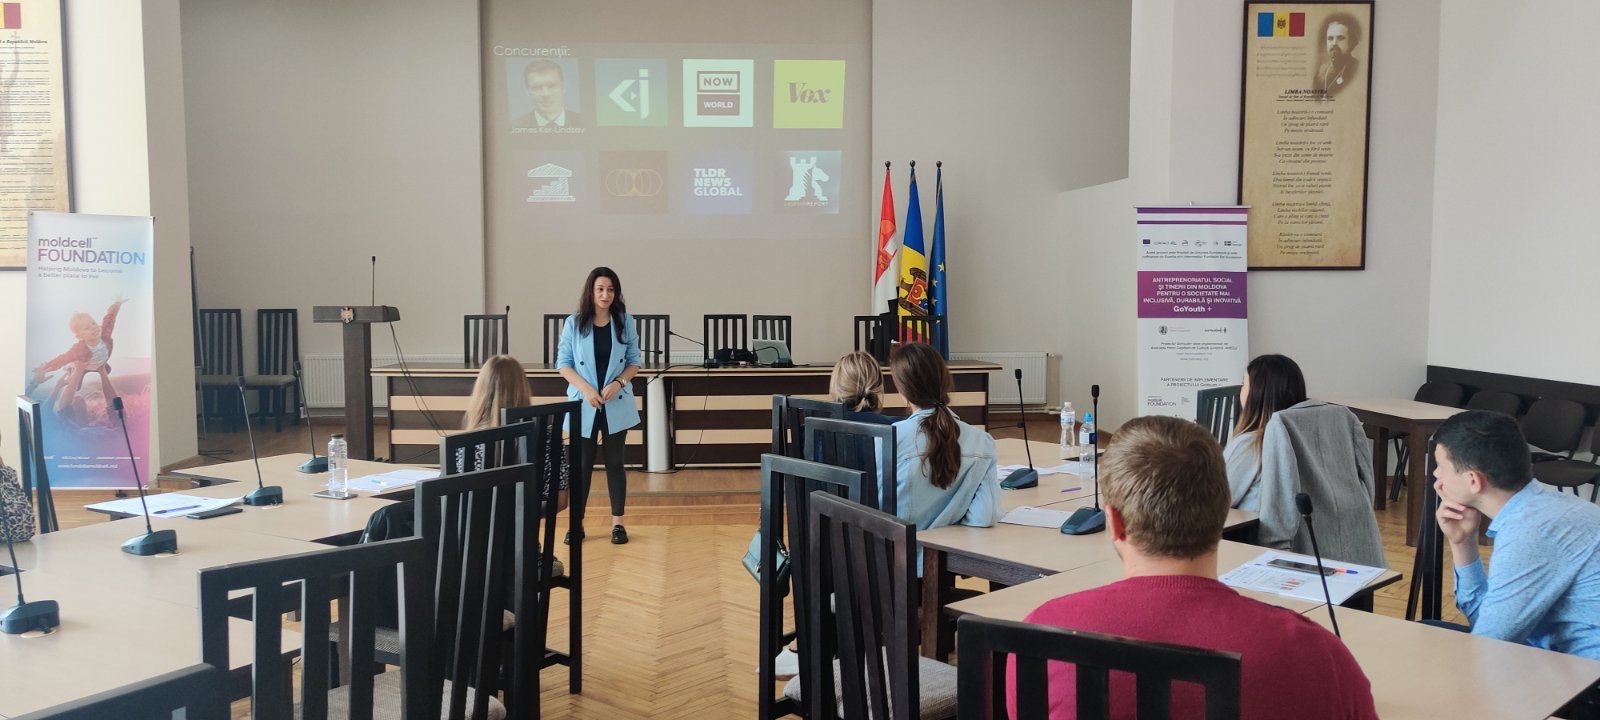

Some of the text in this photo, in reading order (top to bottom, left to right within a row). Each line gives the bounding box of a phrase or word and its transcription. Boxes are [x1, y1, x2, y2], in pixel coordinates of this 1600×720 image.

[704, 77, 734, 87] NOW
[788, 82, 832, 104] Vox
[693, 168, 726, 178] TLDR
[694, 178, 732, 187] NEWS
[694, 187, 743, 196] GLOBAL
[38, 236, 92, 248] moldcell
[38, 248, 145, 265] FOUNDATION
